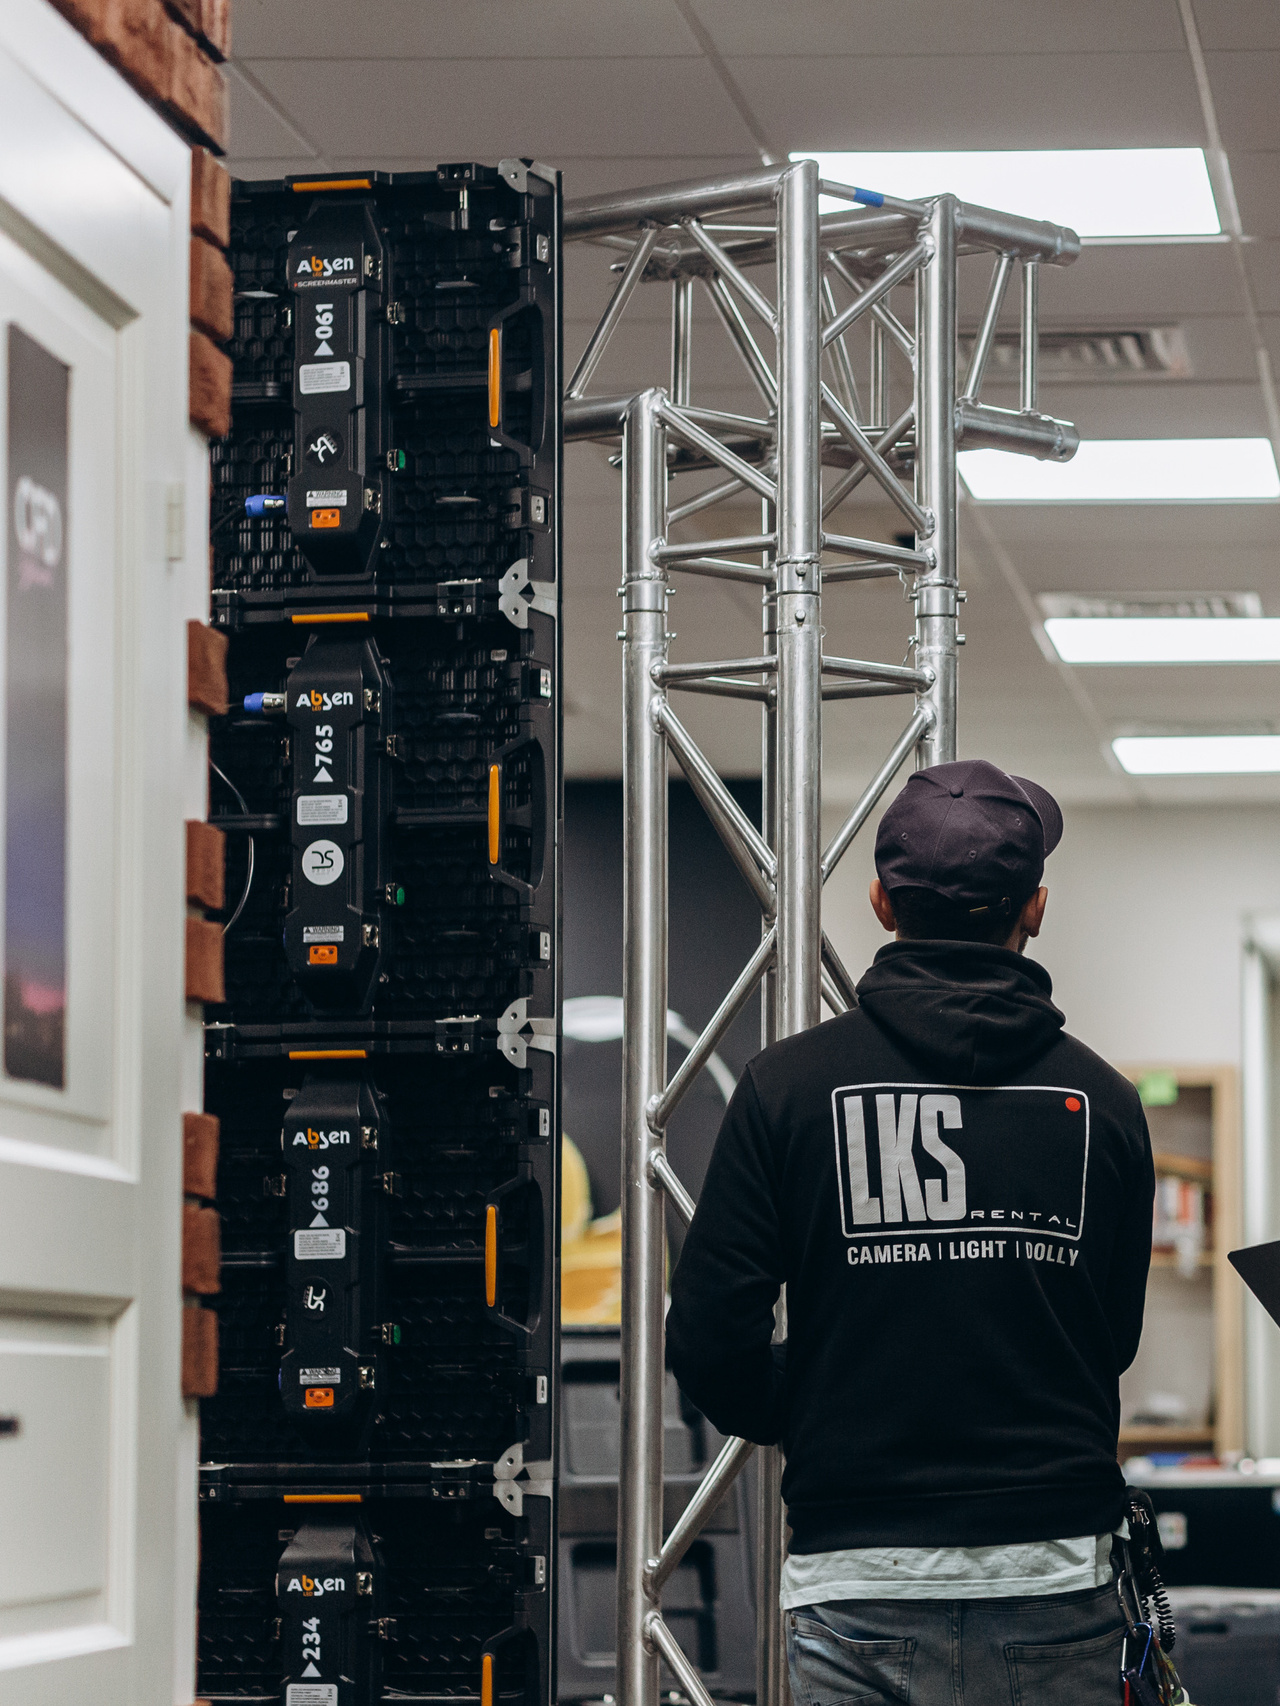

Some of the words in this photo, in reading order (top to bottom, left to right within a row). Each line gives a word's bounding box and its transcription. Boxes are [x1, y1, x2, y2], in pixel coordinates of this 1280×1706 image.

[297, 255, 354, 277] Absen
[297, 278, 357, 288] SCREENMASTER
[315, 303, 334, 339] 061
[296, 689, 354, 711] Absen
[314, 724, 333, 765] 765
[292, 1127, 351, 1149] Absen
[843, 1093, 967, 1225] LKS
[312, 1165, 330, 1211] 686
[970, 1209, 1077, 1228] RENTAL
[847, 1243, 931, 1265] CAMERA
[949, 1240, 1007, 1260] LIGHT
[1025, 1241, 1079, 1267] DOLLY
[287, 1574, 345, 1597] Absen
[302, 1616, 321, 1661] 234
